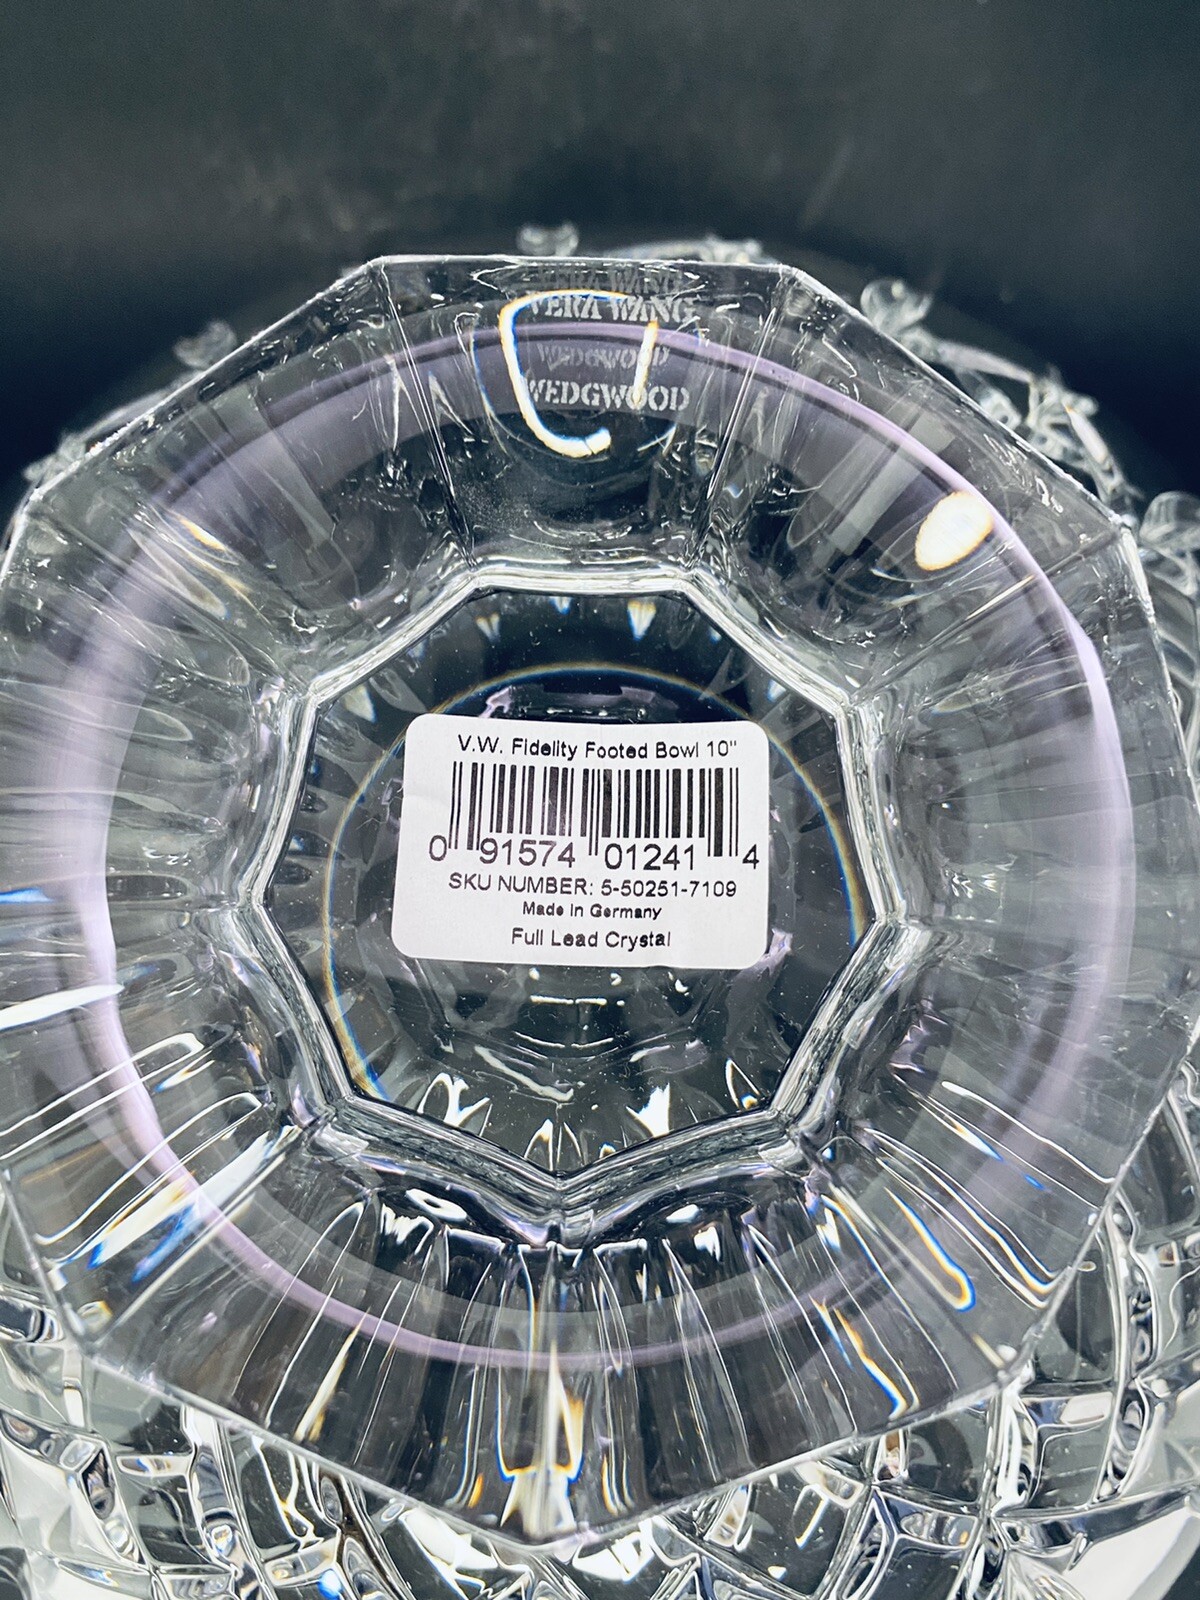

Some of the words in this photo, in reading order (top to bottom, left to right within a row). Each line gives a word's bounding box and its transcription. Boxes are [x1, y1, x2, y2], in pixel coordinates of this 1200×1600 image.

[529, 295, 602, 321] VERA
[606, 295, 699, 323] WANG
[458, 735, 502, 753] V.W.
[512, 738, 577, 761] Fidelity
[586, 741, 647, 759] Footed
[656, 742, 698, 758] Bowl
[707, 740, 736, 756] 10"
[429, 834, 448, 862] 0
[479, 838, 576, 868] 91574
[604, 842, 695, 871] 01241
[743, 844, 759, 869] 4
[449, 872, 491, 890] SKU
[498, 876, 592, 895] NUMBER:
[601, 879, 736, 897] 5-50251-7109
[523, 901, 563, 916] Made
[590, 904, 662, 920] Germany
[512, 928, 543, 945] Full
[552, 930, 598, 947] Lead
[606, 931, 670, 952] Crystal
